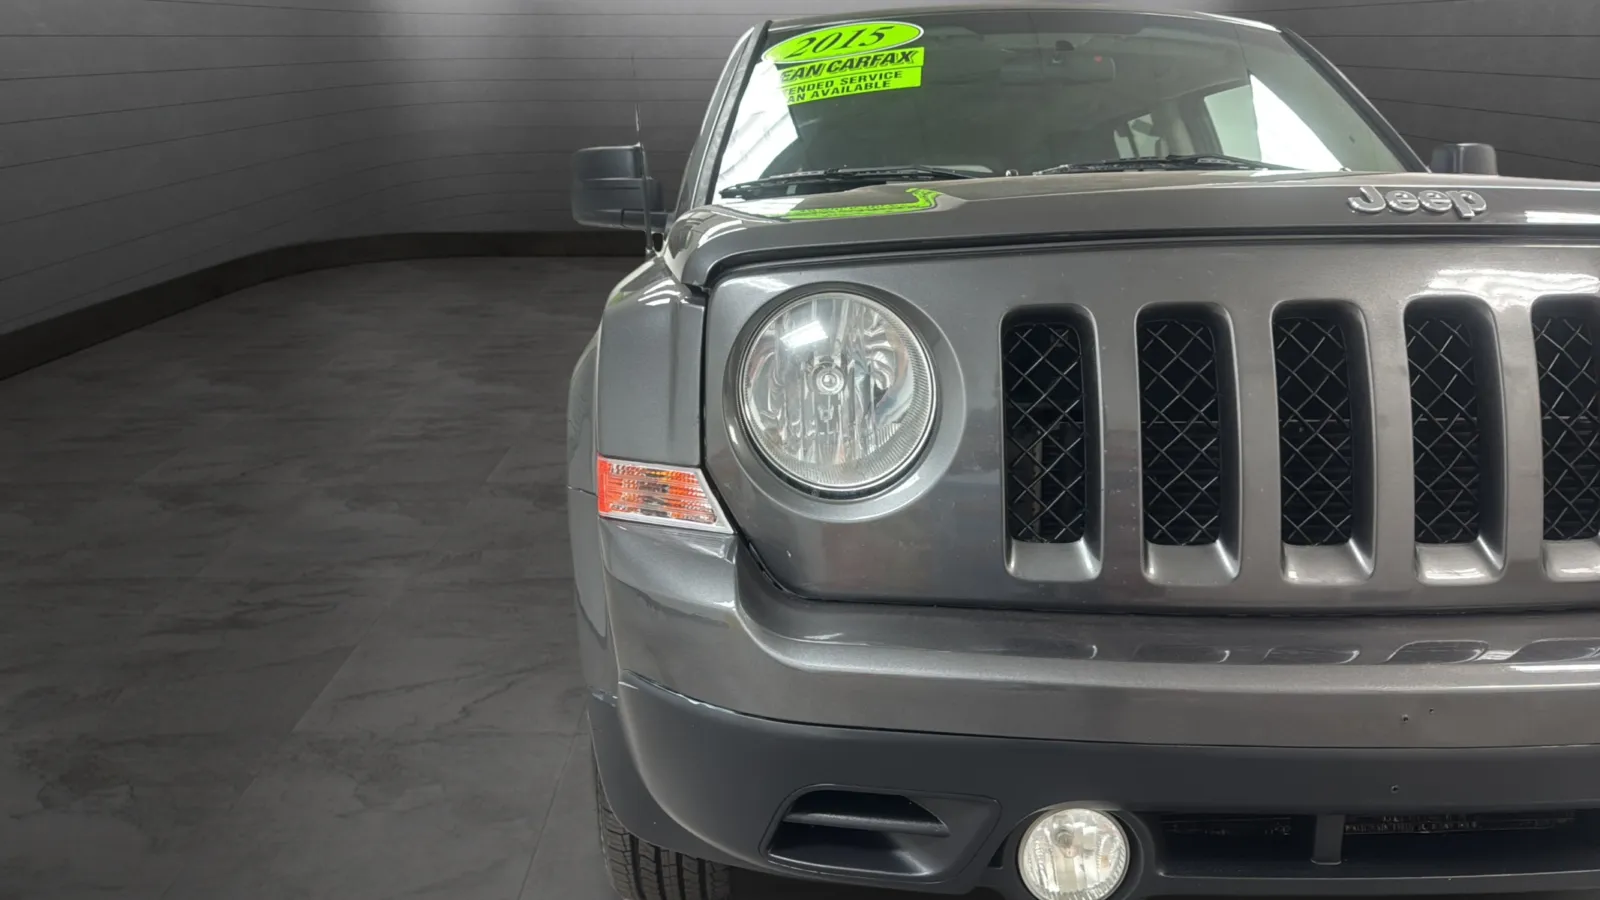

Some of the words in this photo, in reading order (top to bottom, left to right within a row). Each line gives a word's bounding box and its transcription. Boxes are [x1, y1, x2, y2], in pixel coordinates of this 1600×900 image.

[785, 25, 895, 59] 2015
[826, 51, 919, 73] CARFAX
[811, 80, 891, 98] AVAILABLE
[840, 71, 902, 85] SERVICE
[1348, 186, 1487, 218] Jeep
